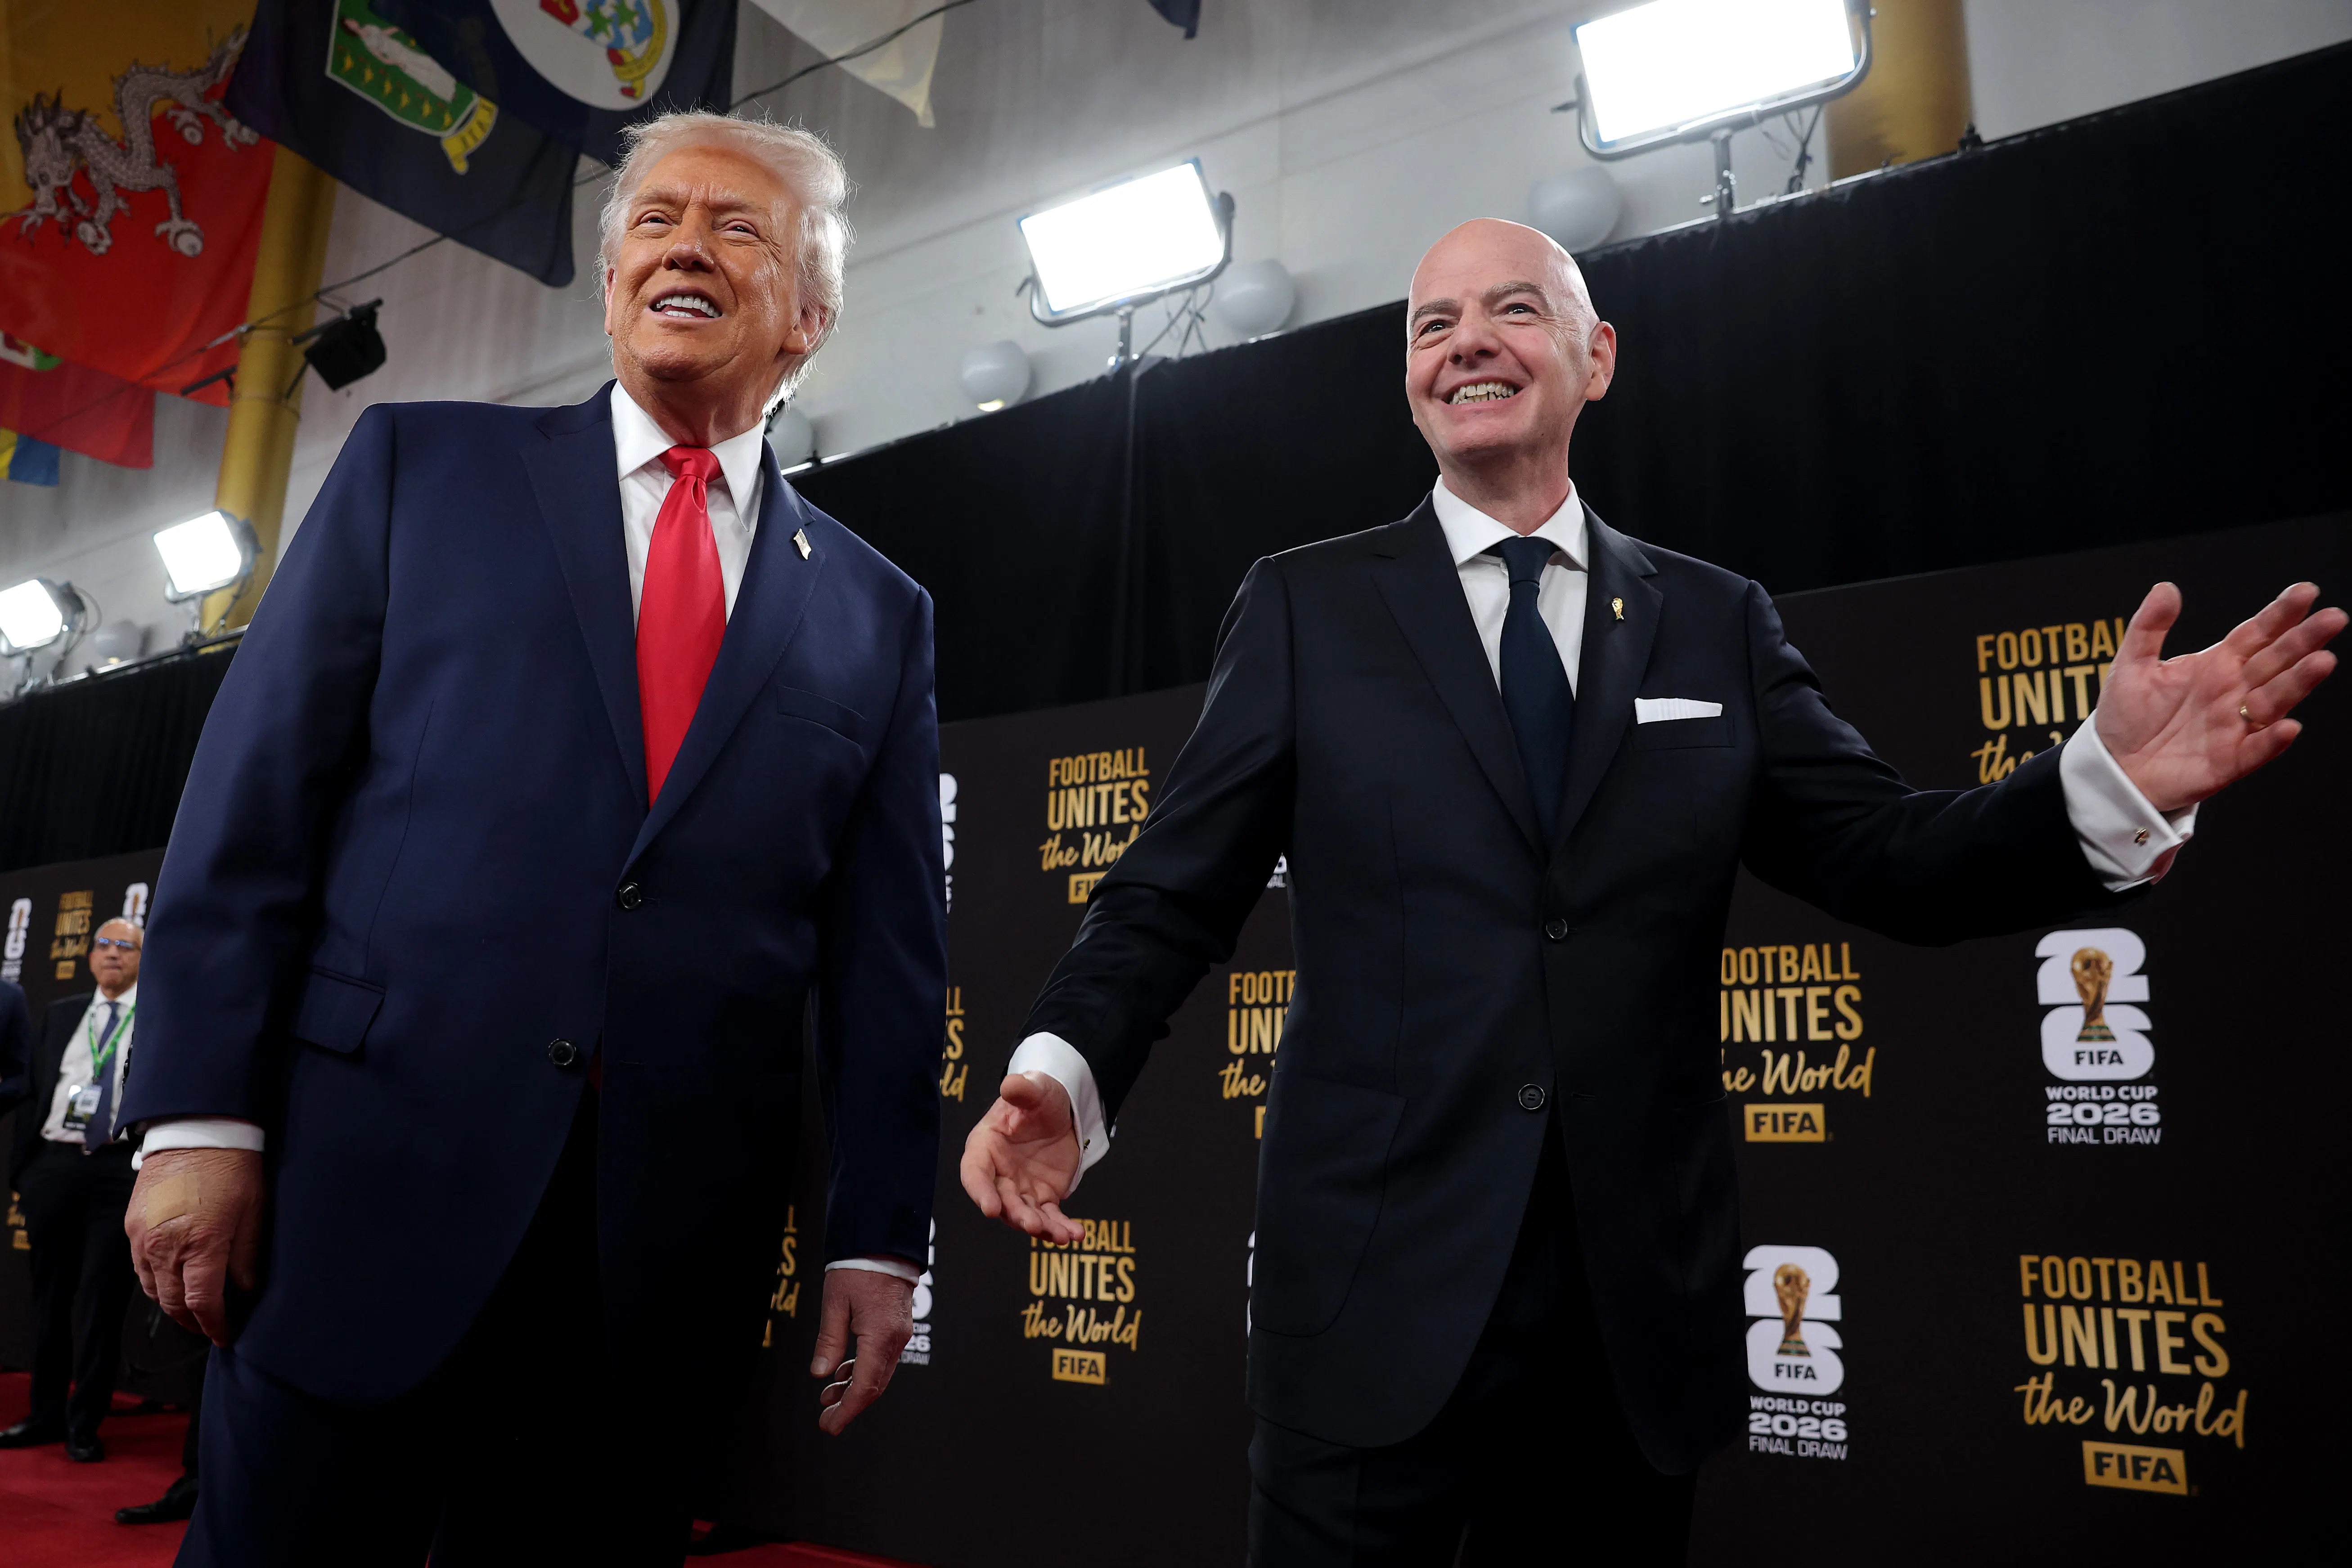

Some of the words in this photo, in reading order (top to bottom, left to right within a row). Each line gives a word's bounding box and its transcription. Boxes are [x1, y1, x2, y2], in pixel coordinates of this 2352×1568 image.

[1979, 662, 2111, 731] UNIT
[1049, 746, 1150, 788] FOOTBALL
[1048, 778, 1149, 831] UNITES
[1039, 833, 1079, 871] the
[1722, 942, 1861, 986] OOTBALL
[1228, 1006, 1289, 1055] UNI
[1761, 1043, 1876, 1098] World
[2075, 1050, 2123, 1065] FIFA
[1218, 1057, 1267, 1099] the
[2044, 1085, 2116, 1101] WORLD
[2117, 1085, 2159, 1101] CUP
[1753, 1112, 1817, 1134] FIFA
[2046, 1101, 2161, 1126] 2026
[2047, 1127, 2100, 1145] FINAL
[2103, 1127, 2163, 1146] DRAW
[1029, 1251, 1136, 1303] UNITES
[2019, 1254, 2224, 1308] FOOTBALL
[1020, 1299, 1064, 1339] the
[1065, 1303, 1143, 1352] World
[2022, 1302, 2230, 1379] UNITES
[1059, 1356, 1101, 1377] FIFA
[1774, 1362, 1817, 1380] FIFA
[1749, 1395, 1809, 1414] WORLD
[1810, 1400, 1847, 1418] CUP
[2013, 1370, 2096, 1425] the
[2100, 1378, 2249, 1449] World
[1748, 1412, 1848, 1442] 2026
[1749, 1435, 1795, 1457] FINAL
[1797, 1439, 1849, 1461] DRAW
[2094, 1450, 2179, 1485] FIFA
